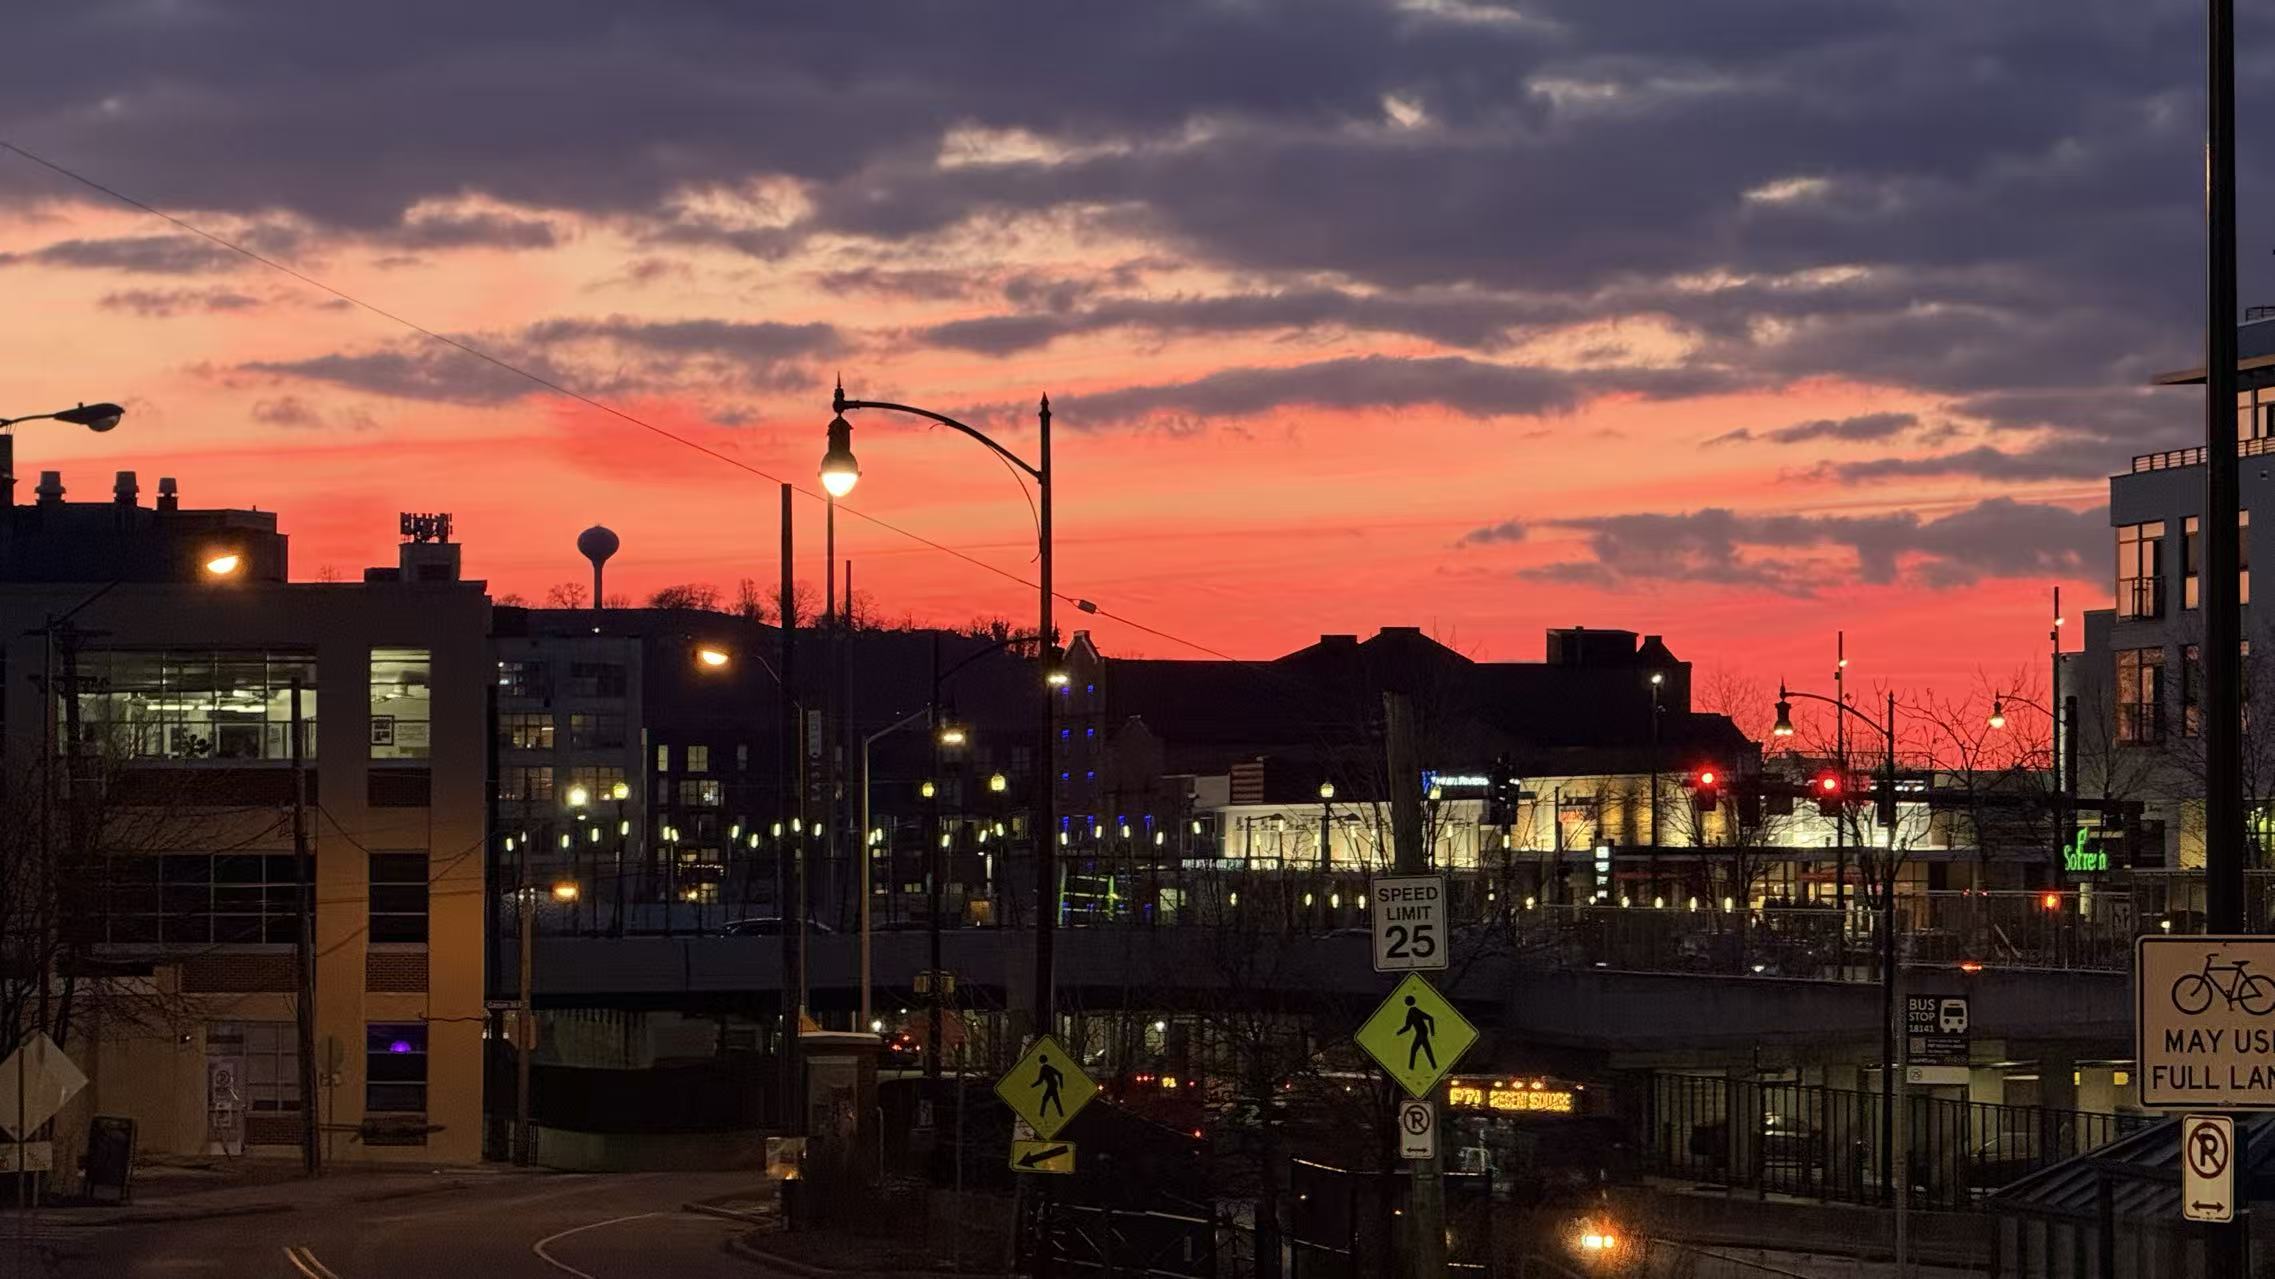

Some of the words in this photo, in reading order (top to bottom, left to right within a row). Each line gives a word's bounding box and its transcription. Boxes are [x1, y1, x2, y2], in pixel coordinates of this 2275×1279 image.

[1378, 887, 1438, 901] SPEED
[1387, 906, 1432, 921] LIMIT
[1385, 924, 1436, 958] 25
[1909, 998, 1936, 1011] BUS
[1909, 1011, 1936, 1022] STOP
[2165, 1029, 2224, 1053] MAY
[2234, 1029, 2275, 1053] US
[2153, 1065, 2220, 1089] FULL
